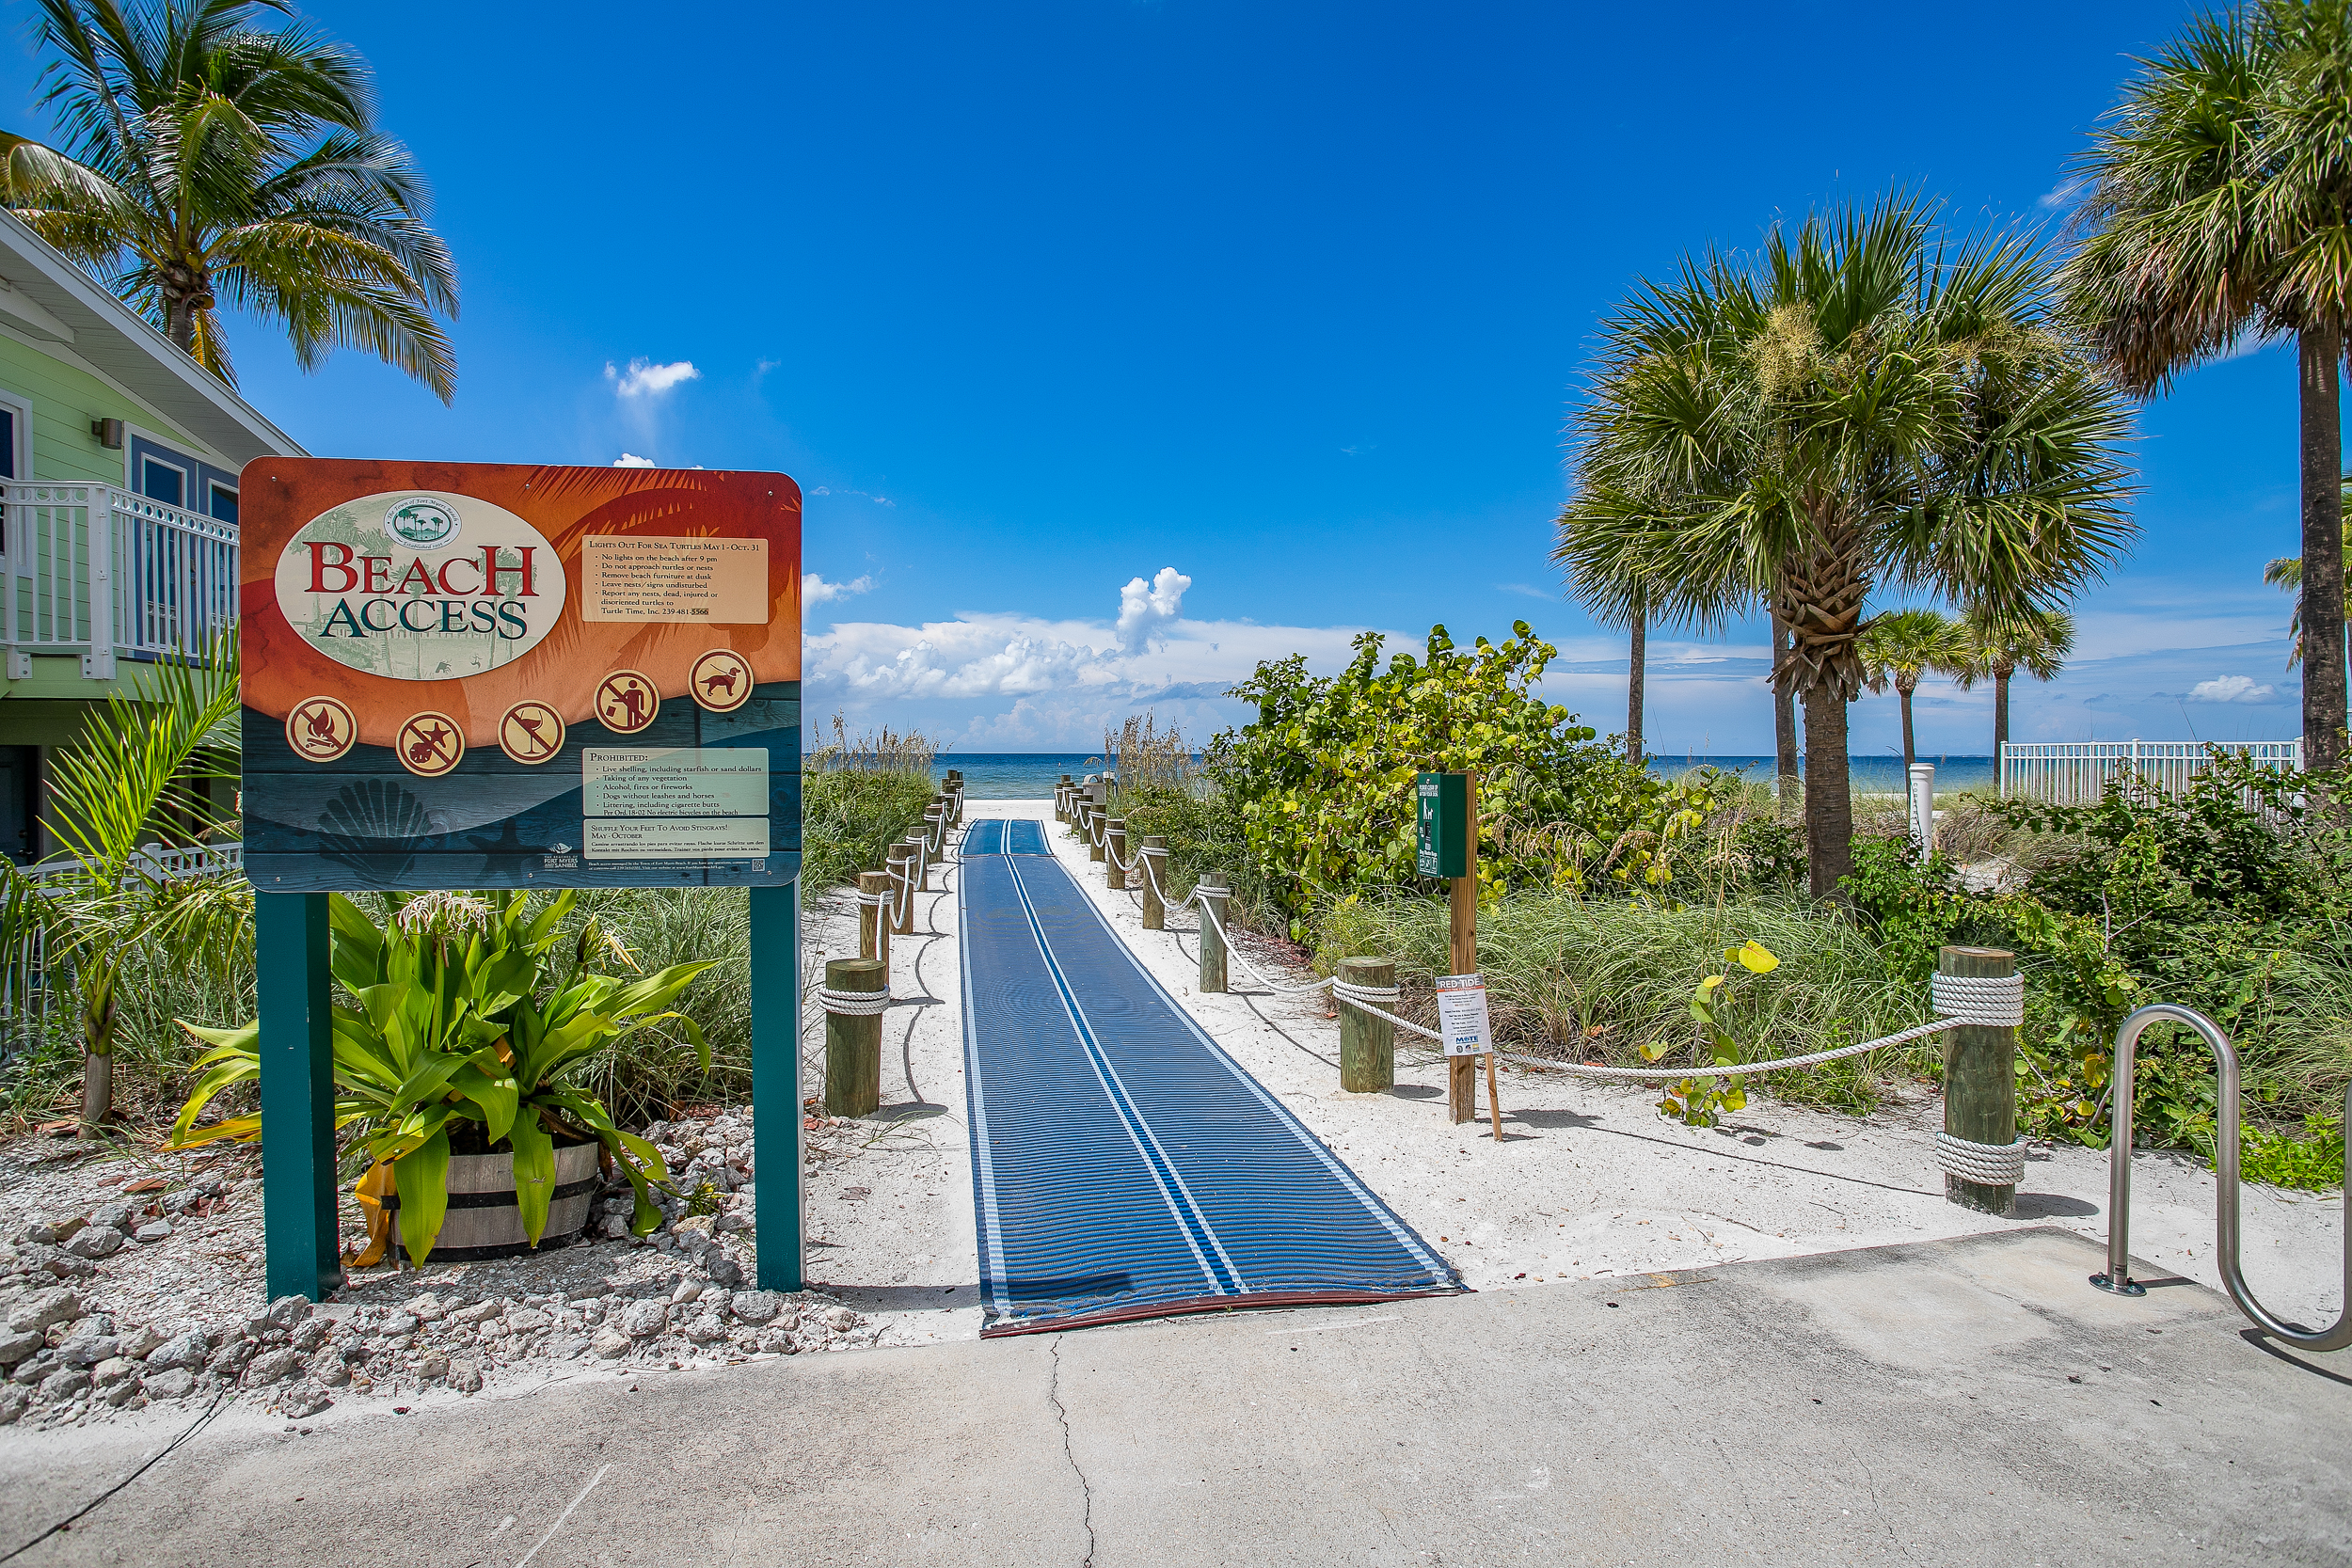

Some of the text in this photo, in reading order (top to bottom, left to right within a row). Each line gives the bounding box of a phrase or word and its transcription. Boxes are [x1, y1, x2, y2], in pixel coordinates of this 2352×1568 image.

[670, 542, 702, 550] TURTLES
[303, 542, 540, 596] BEACH
[319, 598, 528, 640] ACCESS
[591, 752, 648, 761] PROHIBITED:
[1459, 978, 1480, 988] TIDE
